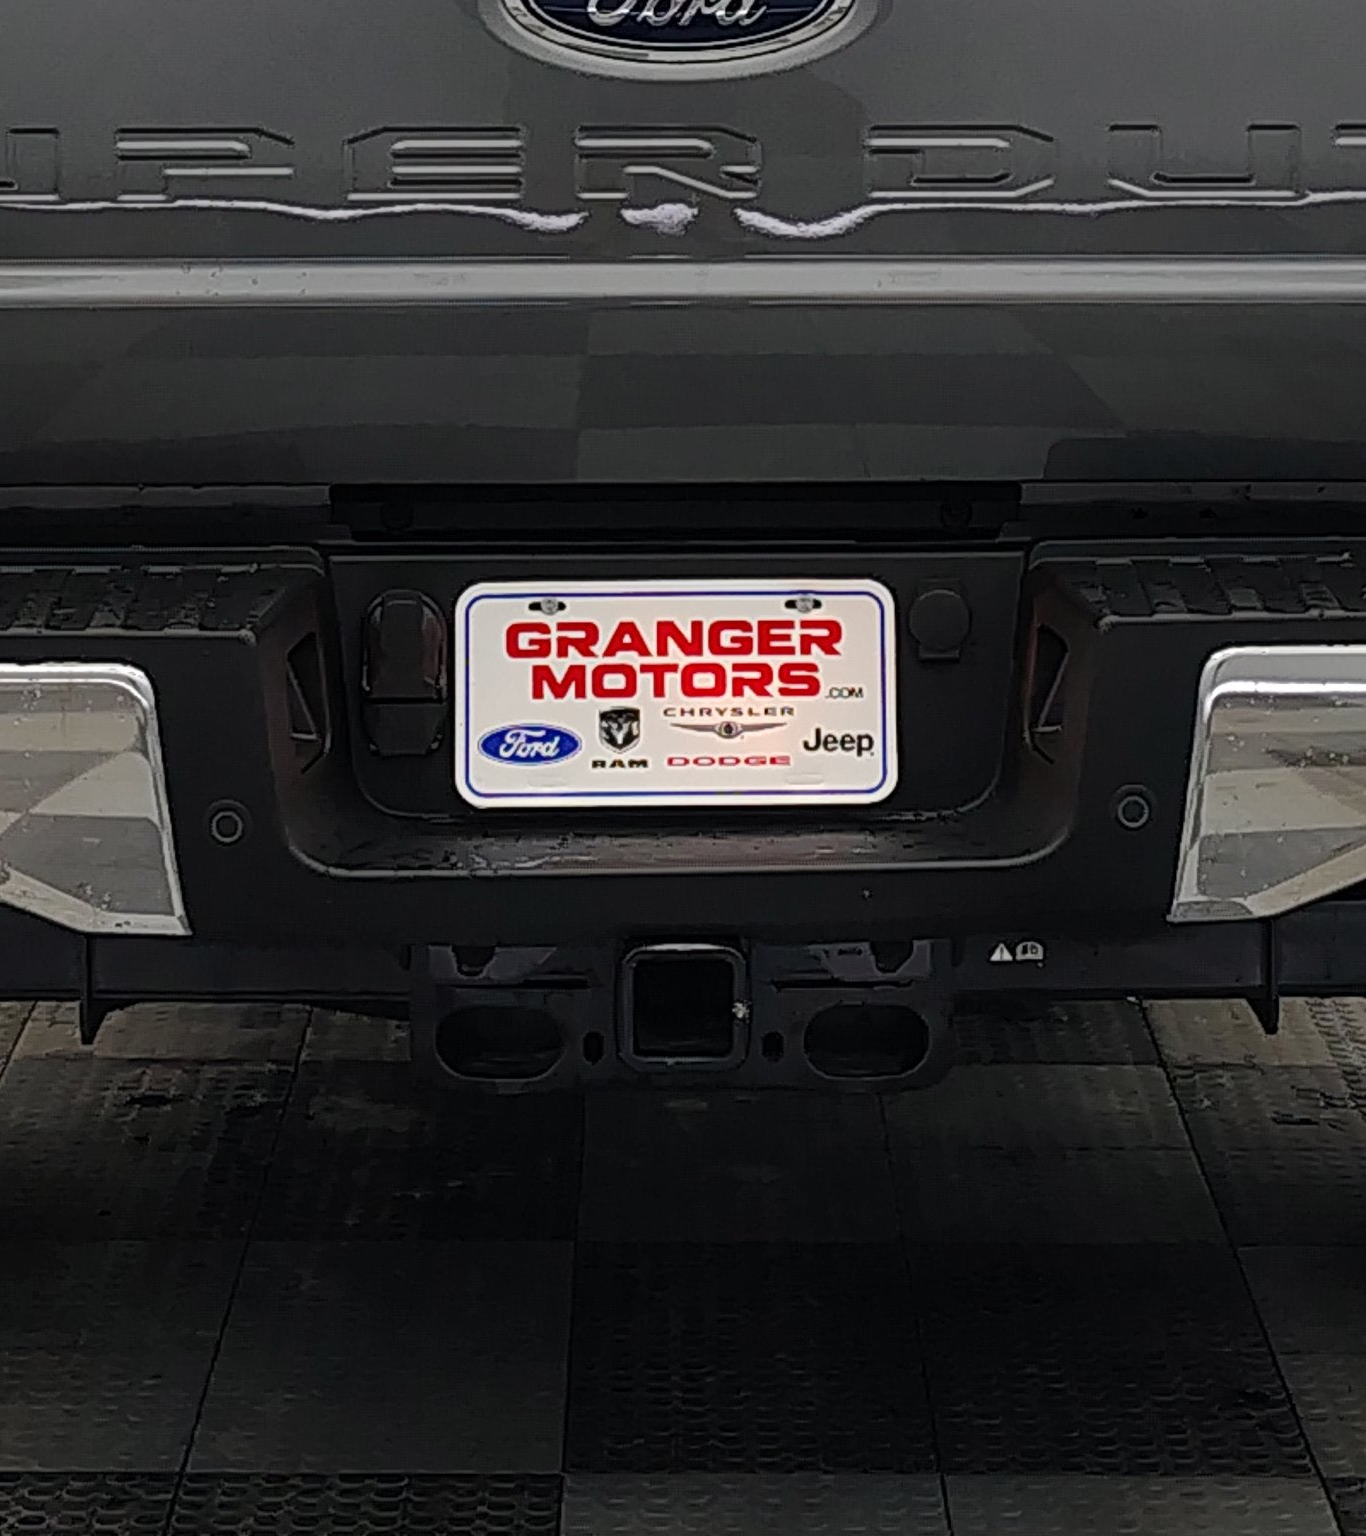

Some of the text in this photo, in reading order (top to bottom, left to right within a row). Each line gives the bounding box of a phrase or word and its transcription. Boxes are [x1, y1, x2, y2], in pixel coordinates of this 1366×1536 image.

[505, 619, 843, 659] GRANGER
[531, 661, 822, 700] MOTORS
[663, 706, 795, 717] CHRYSLER
[498, 728, 561, 759] Ford
[803, 727, 875, 758] Jeep
[591, 758, 650, 769] RAM
[666, 755, 791, 767] DODGE
